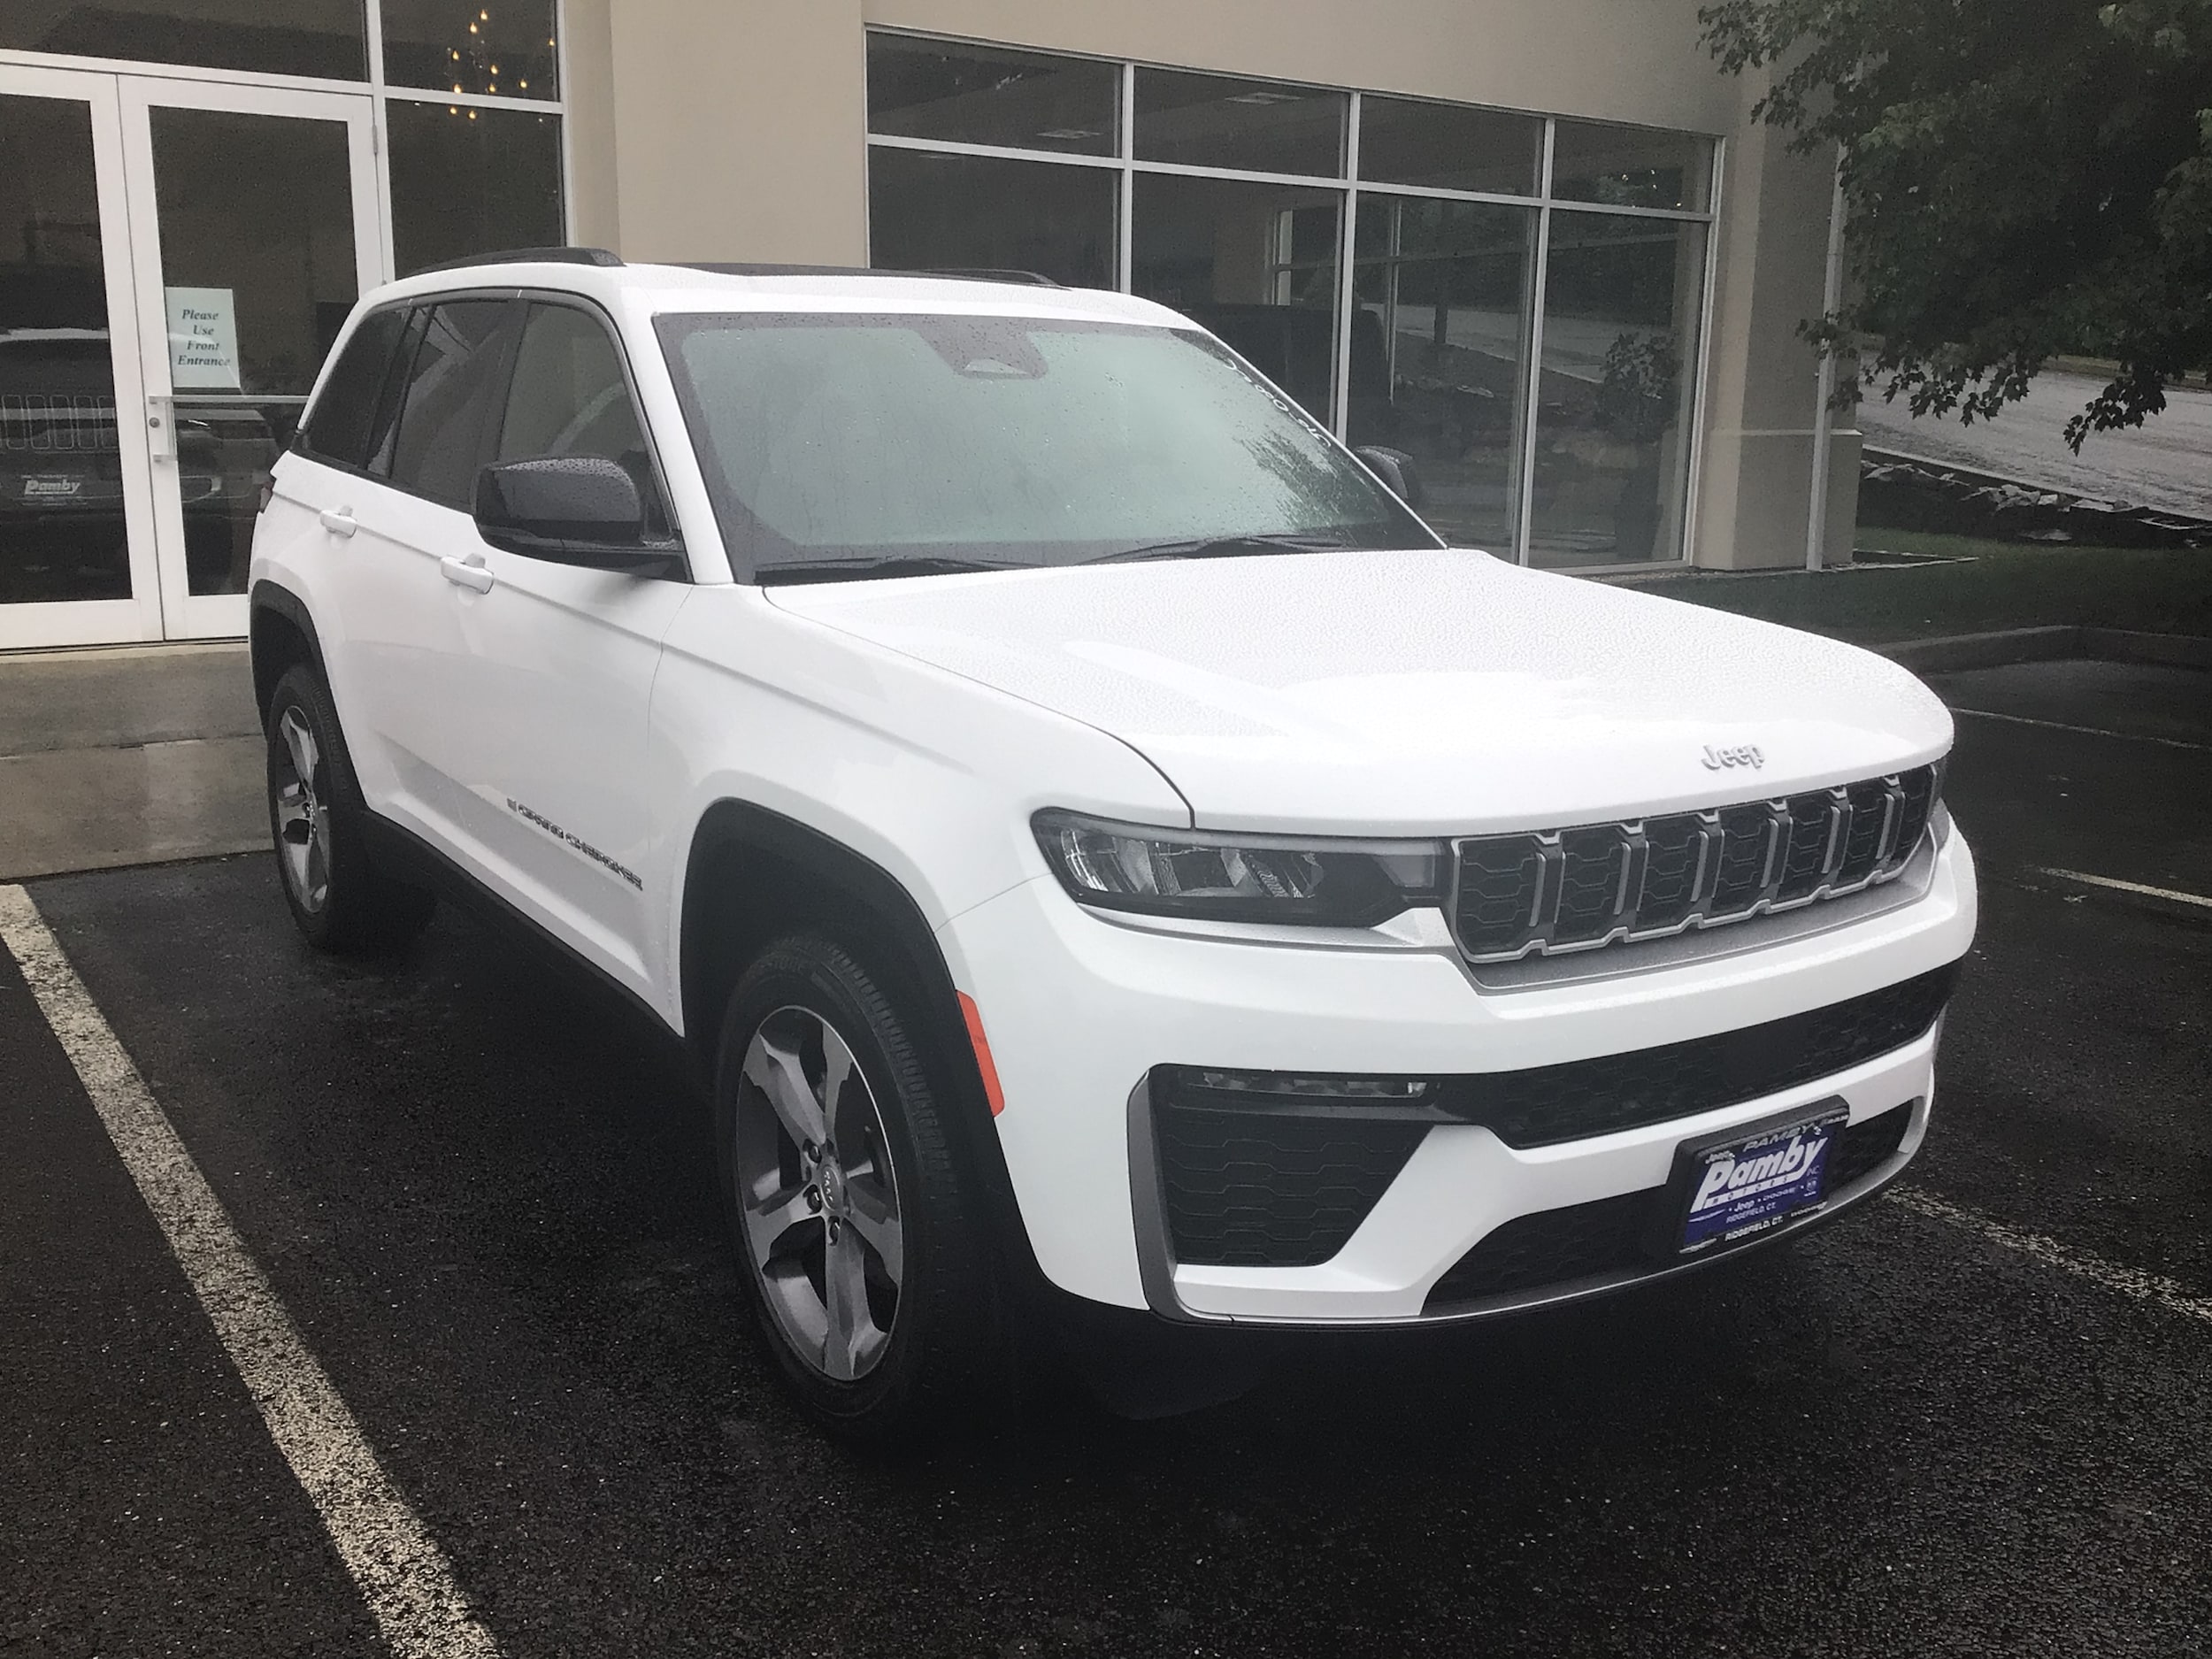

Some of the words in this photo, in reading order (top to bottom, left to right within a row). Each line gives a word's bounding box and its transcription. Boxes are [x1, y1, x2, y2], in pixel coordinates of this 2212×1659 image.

[181, 309, 219, 320] Please
[193, 324, 214, 335] Use
[187, 340, 219, 350] Front
[178, 355, 230, 366] Entrance
[1701, 743, 1764, 771] Jeep
[1690, 1135, 1828, 1213] Pamby
